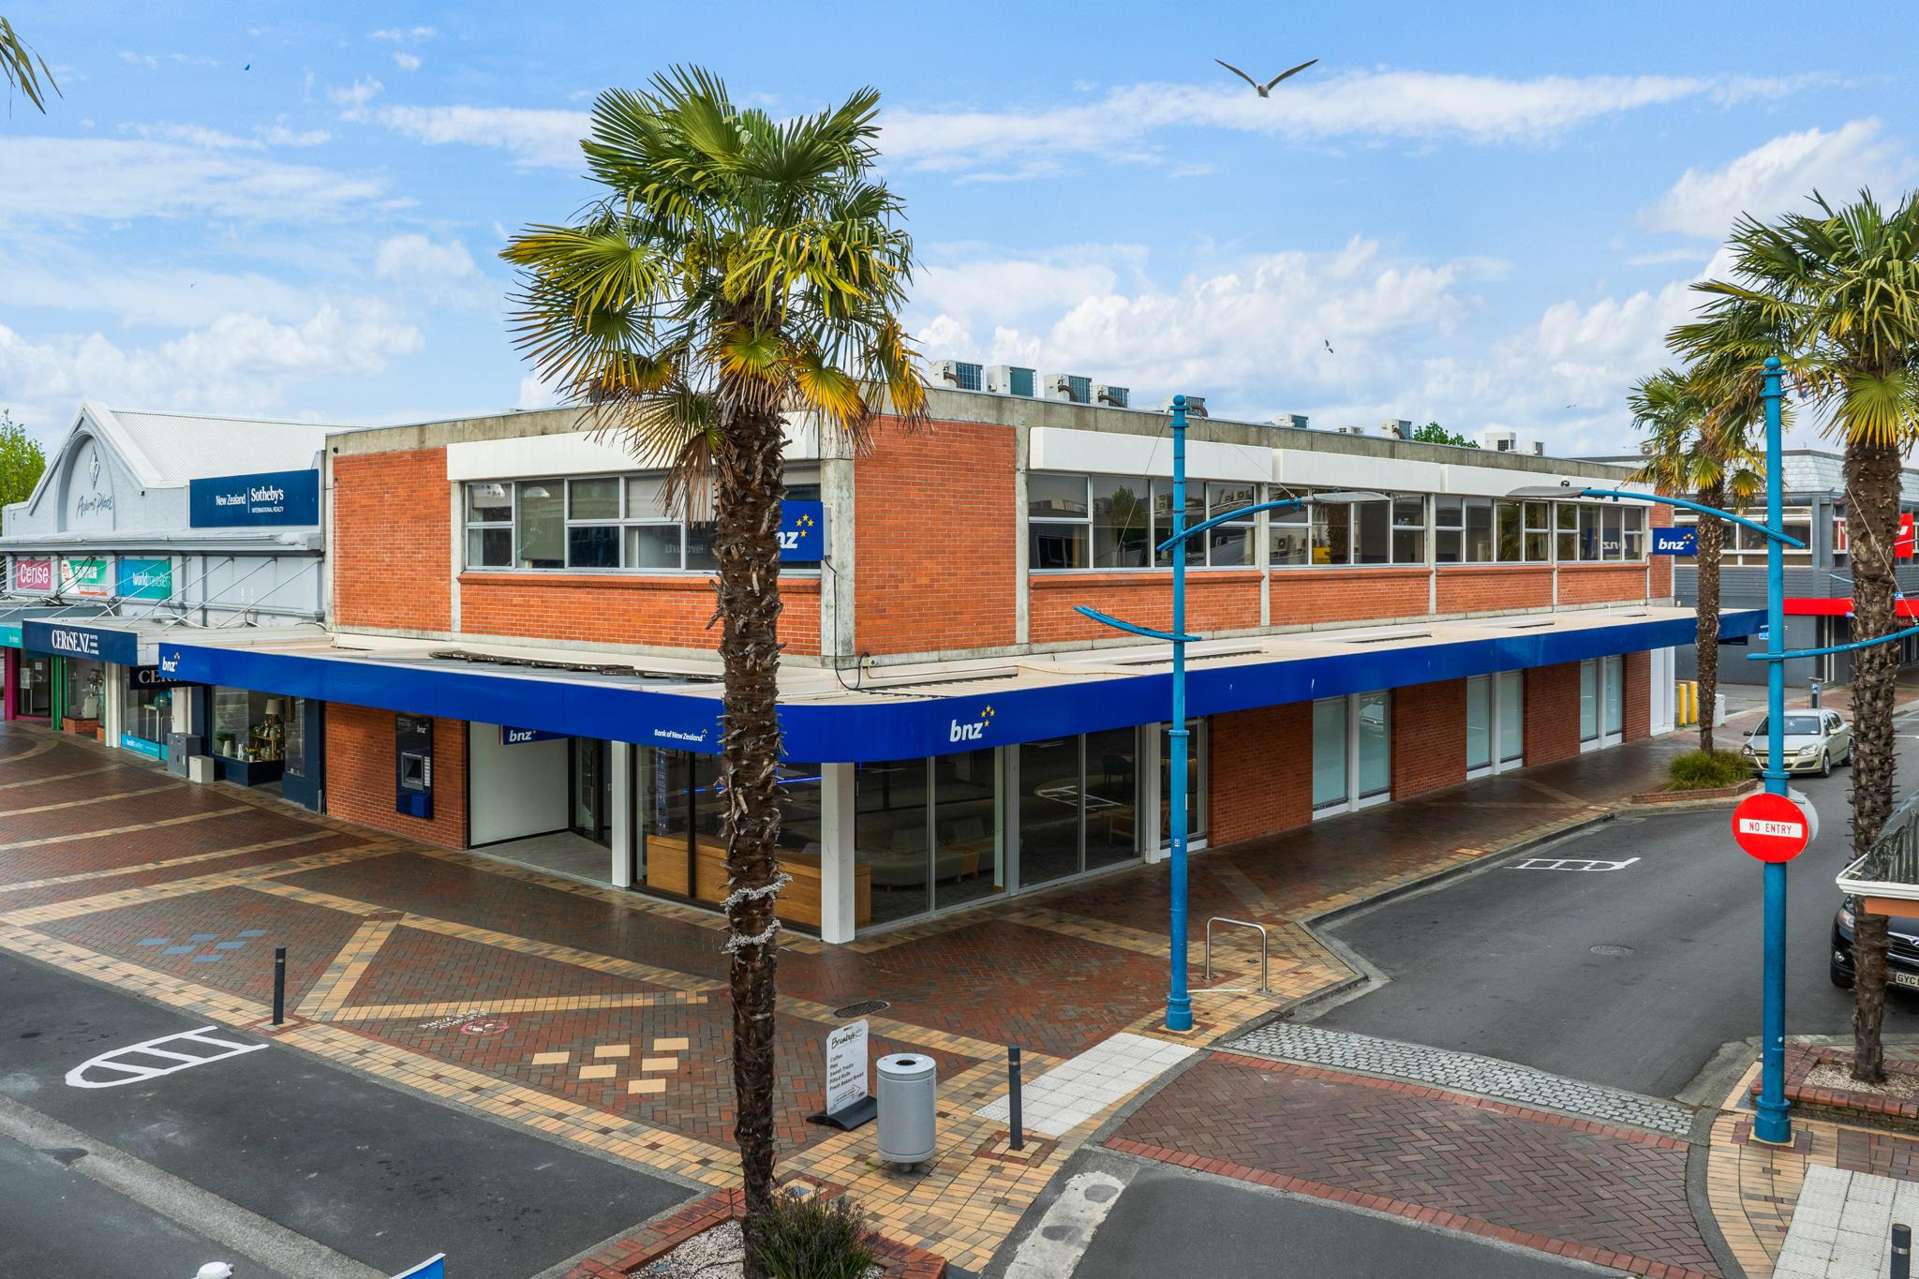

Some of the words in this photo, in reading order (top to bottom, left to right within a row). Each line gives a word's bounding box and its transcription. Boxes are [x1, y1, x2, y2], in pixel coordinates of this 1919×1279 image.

[216, 495, 226, 505] New
[227, 494, 246, 505] Zealand
[251, 485, 284, 504] Sotheby's
[775, 531, 799, 549] nz
[1658, 538, 1685, 550] bnz
[20, 564, 49, 584] Cerise
[162, 656, 176, 672] bnz
[509, 729, 533, 742] bnz
[655, 729, 666, 737] Bank
[683, 732, 703, 742] Zealand
[950, 719, 984, 742] bnz
[1749, 821, 1760, 832] NO
[1765, 823, 1792, 835] ENTRY
